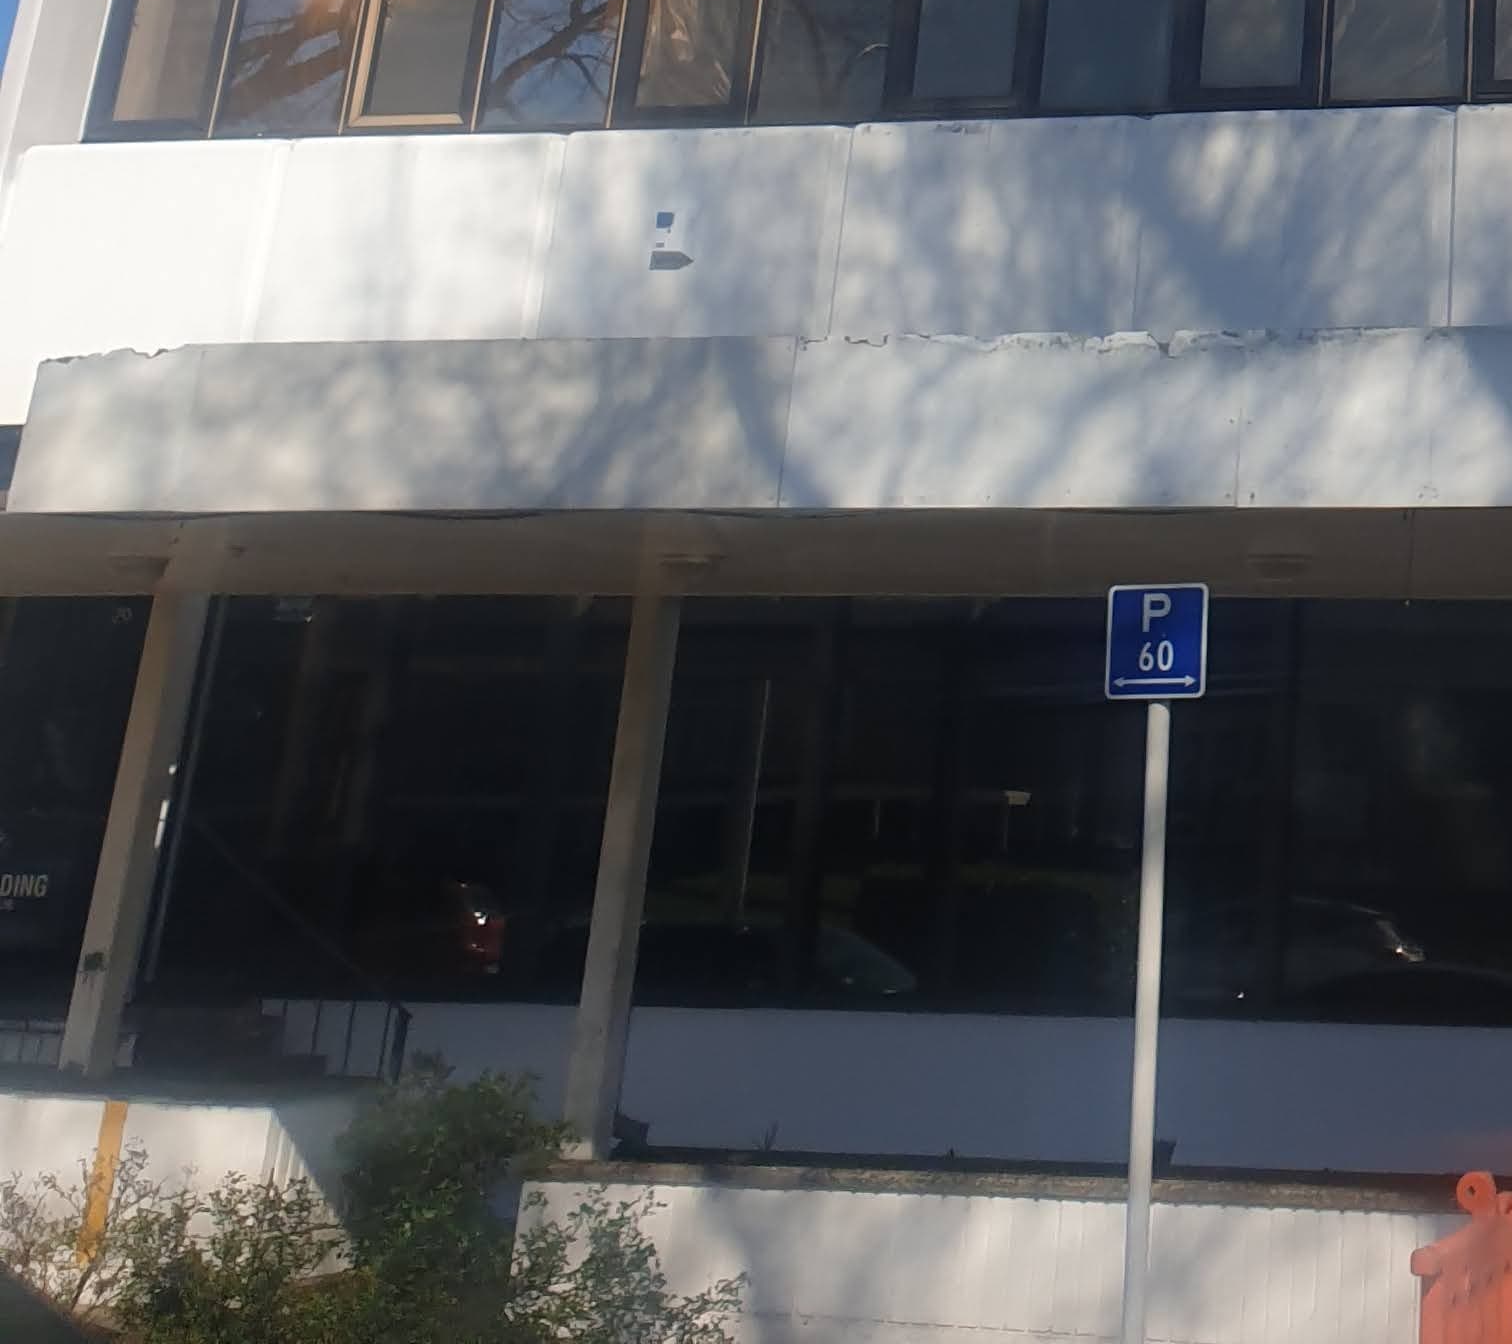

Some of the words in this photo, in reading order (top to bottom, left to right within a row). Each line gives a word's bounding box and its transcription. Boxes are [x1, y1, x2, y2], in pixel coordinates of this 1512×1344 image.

[1142, 592, 1172, 632] P
[1139, 640, 1174, 672] 60
[0, 873, 48, 897] DING
